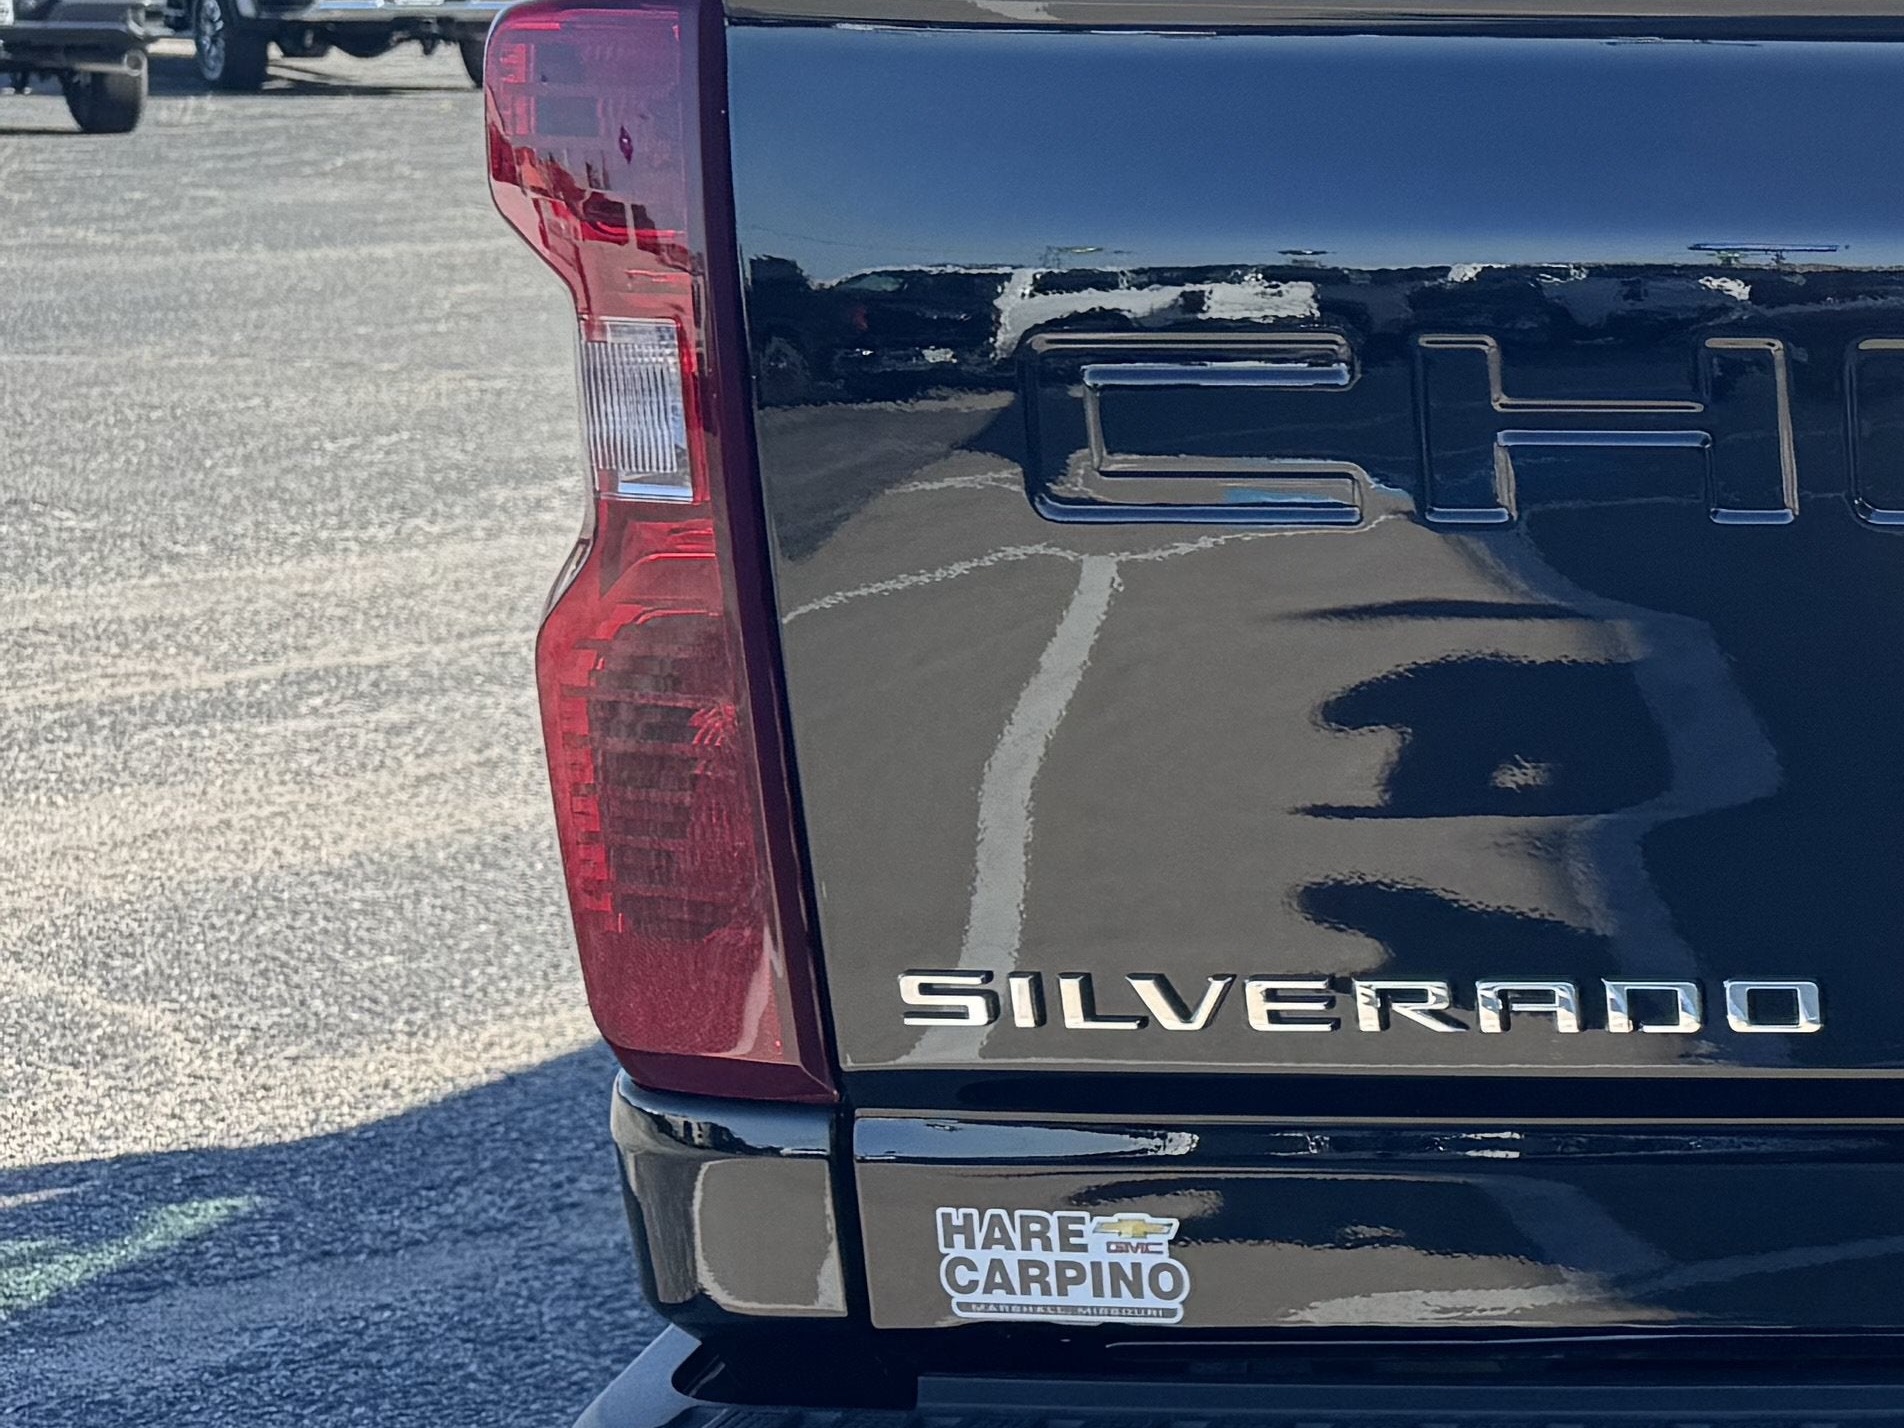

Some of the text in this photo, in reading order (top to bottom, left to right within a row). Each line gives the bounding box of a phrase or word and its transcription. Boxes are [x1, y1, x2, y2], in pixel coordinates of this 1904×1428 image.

[899, 970, 1824, 1034] SILVERADO
[941, 1212, 1088, 1253] HARE
[1106, 1241, 1164, 1254] GMC
[945, 1256, 1184, 1301] CARPINO
